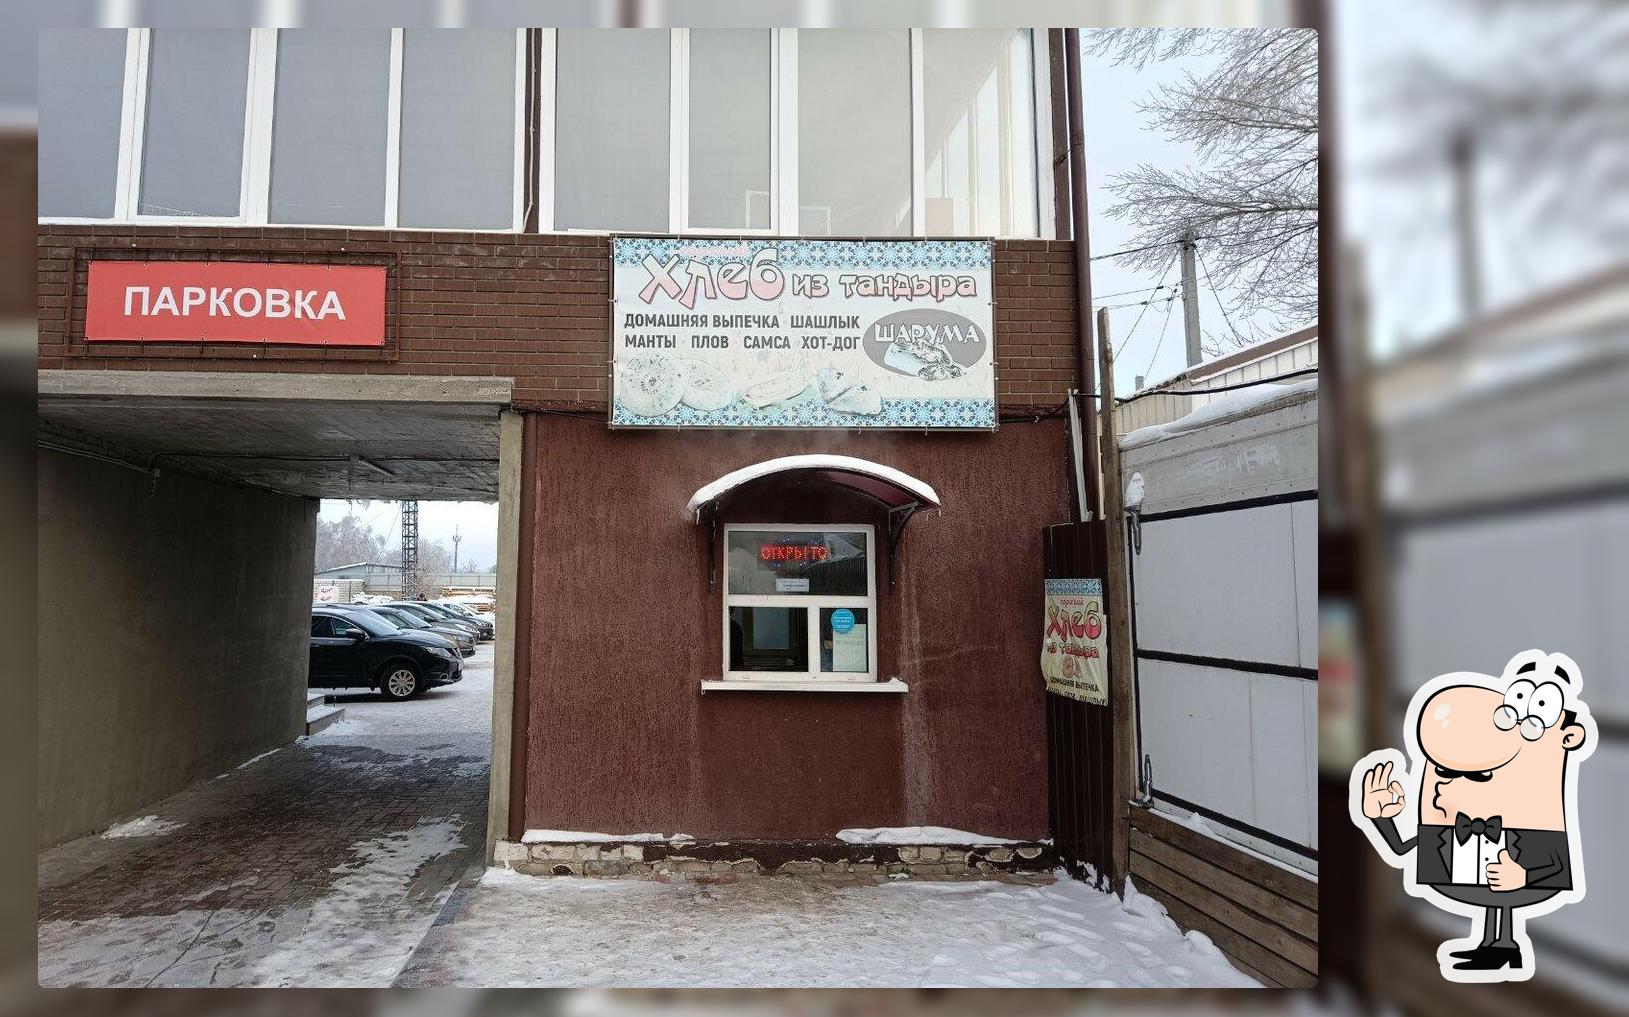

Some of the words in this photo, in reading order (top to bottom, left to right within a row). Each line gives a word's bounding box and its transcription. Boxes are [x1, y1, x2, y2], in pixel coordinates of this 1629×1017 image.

[792, 273, 829, 299] из
[839, 273, 976, 302] тандыра
[123, 286, 346, 321] ПАРКОВКА
[624, 313, 708, 329] ДОМАШНЯЯ
[712, 314, 780, 330] ВЫПЕЧКА
[790, 315, 860, 330] ШАШЛЫК
[625, 335, 677, 350] МАНТЫ
[690, 336, 729, 350] ПЛОВ
[743, 336, 791, 351] САМСА
[801, 336, 861, 352] ХОТ-ДОГ
[874, 322, 980, 345] ШАРУМА
[761, 544, 828, 560] ОТКРЫТО
